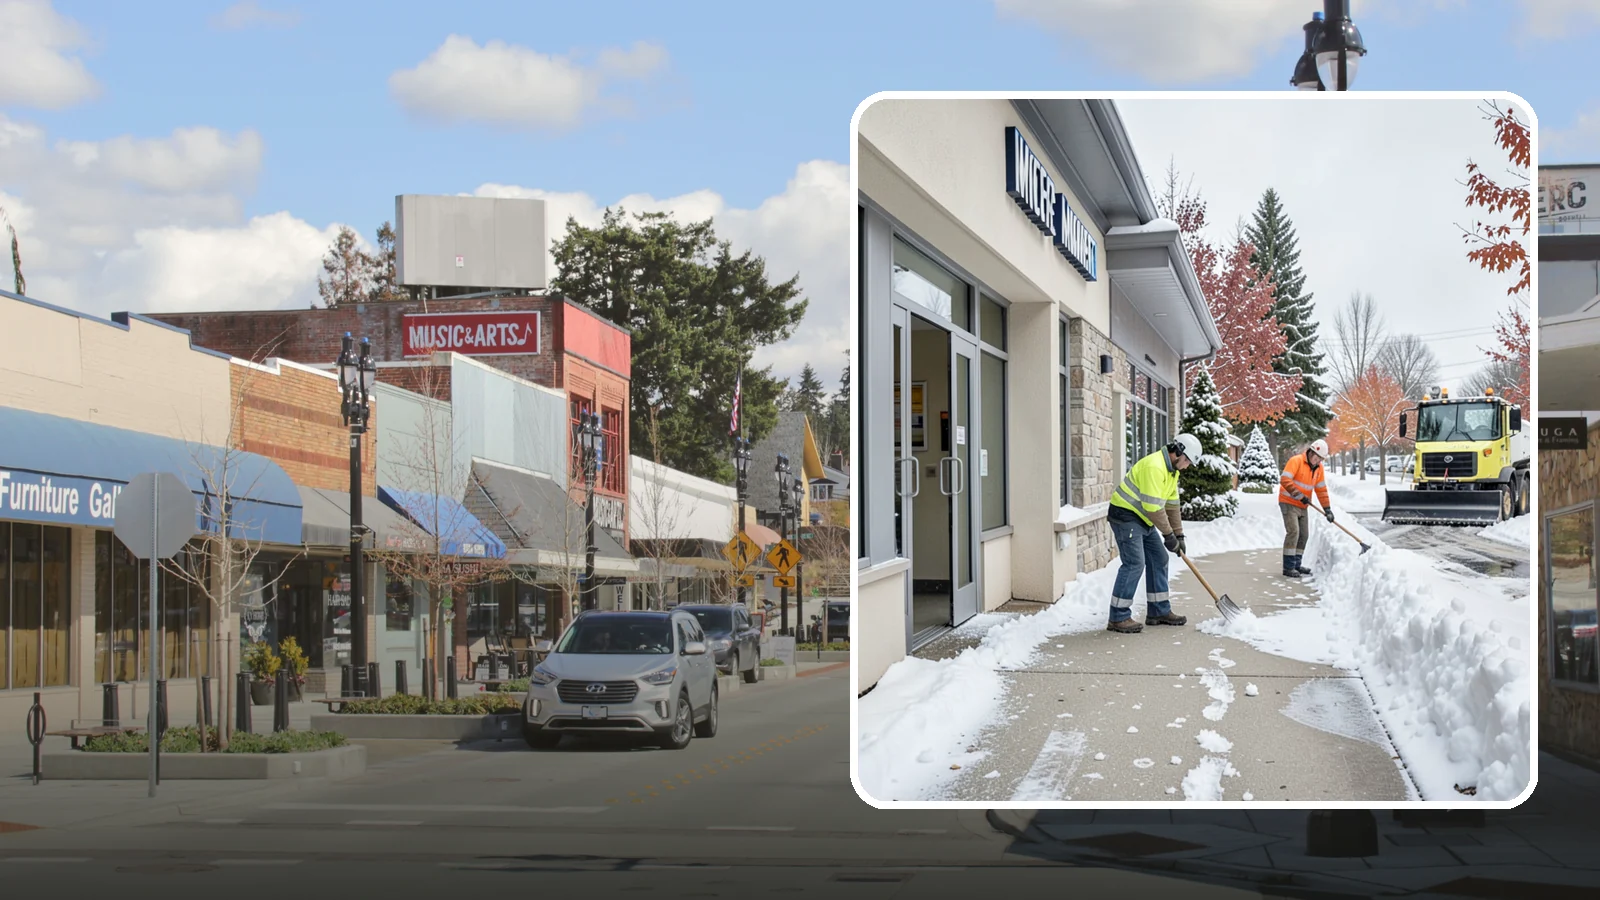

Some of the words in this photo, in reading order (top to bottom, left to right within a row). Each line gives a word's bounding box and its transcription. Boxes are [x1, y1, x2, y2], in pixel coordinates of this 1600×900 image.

[409, 323, 520, 349] MUSIC&ARTS
[1540, 427, 1578, 437] UGA
[0, 471, 80, 515] Furniture
[89, 482, 122, 519] Gal
[452, 563, 480, 574] SUSHI
